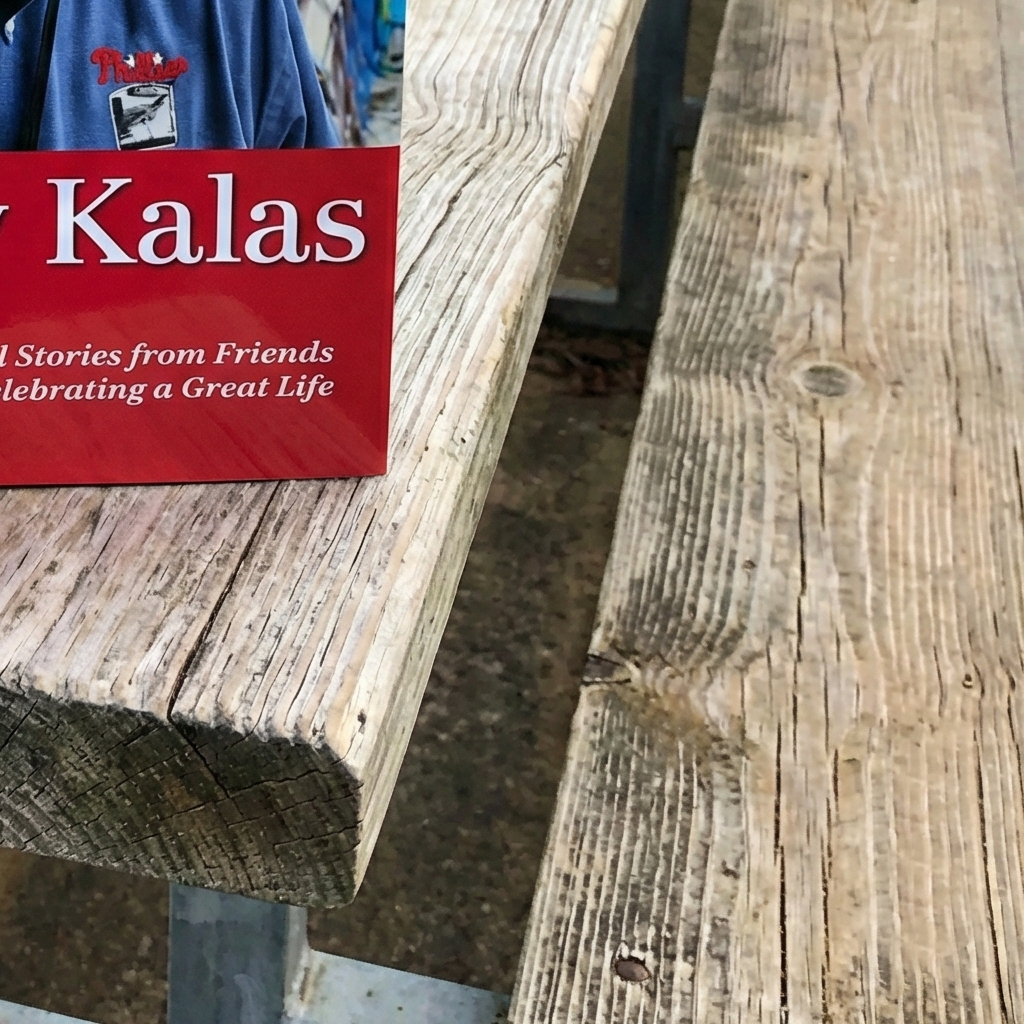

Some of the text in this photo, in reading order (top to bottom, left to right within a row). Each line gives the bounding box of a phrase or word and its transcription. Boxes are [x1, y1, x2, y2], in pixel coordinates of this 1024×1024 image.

[90, 45, 189, 86] Phillies
[46, 172, 365, 265] Kalas
[14, 343, 122, 368] Stories
[123, 342, 206, 373] from
[212, 340, 334, 365] Friends
[153, 382, 173, 399] a
[181, 376, 271, 399] Great
[275, 373, 335, 404] Life
